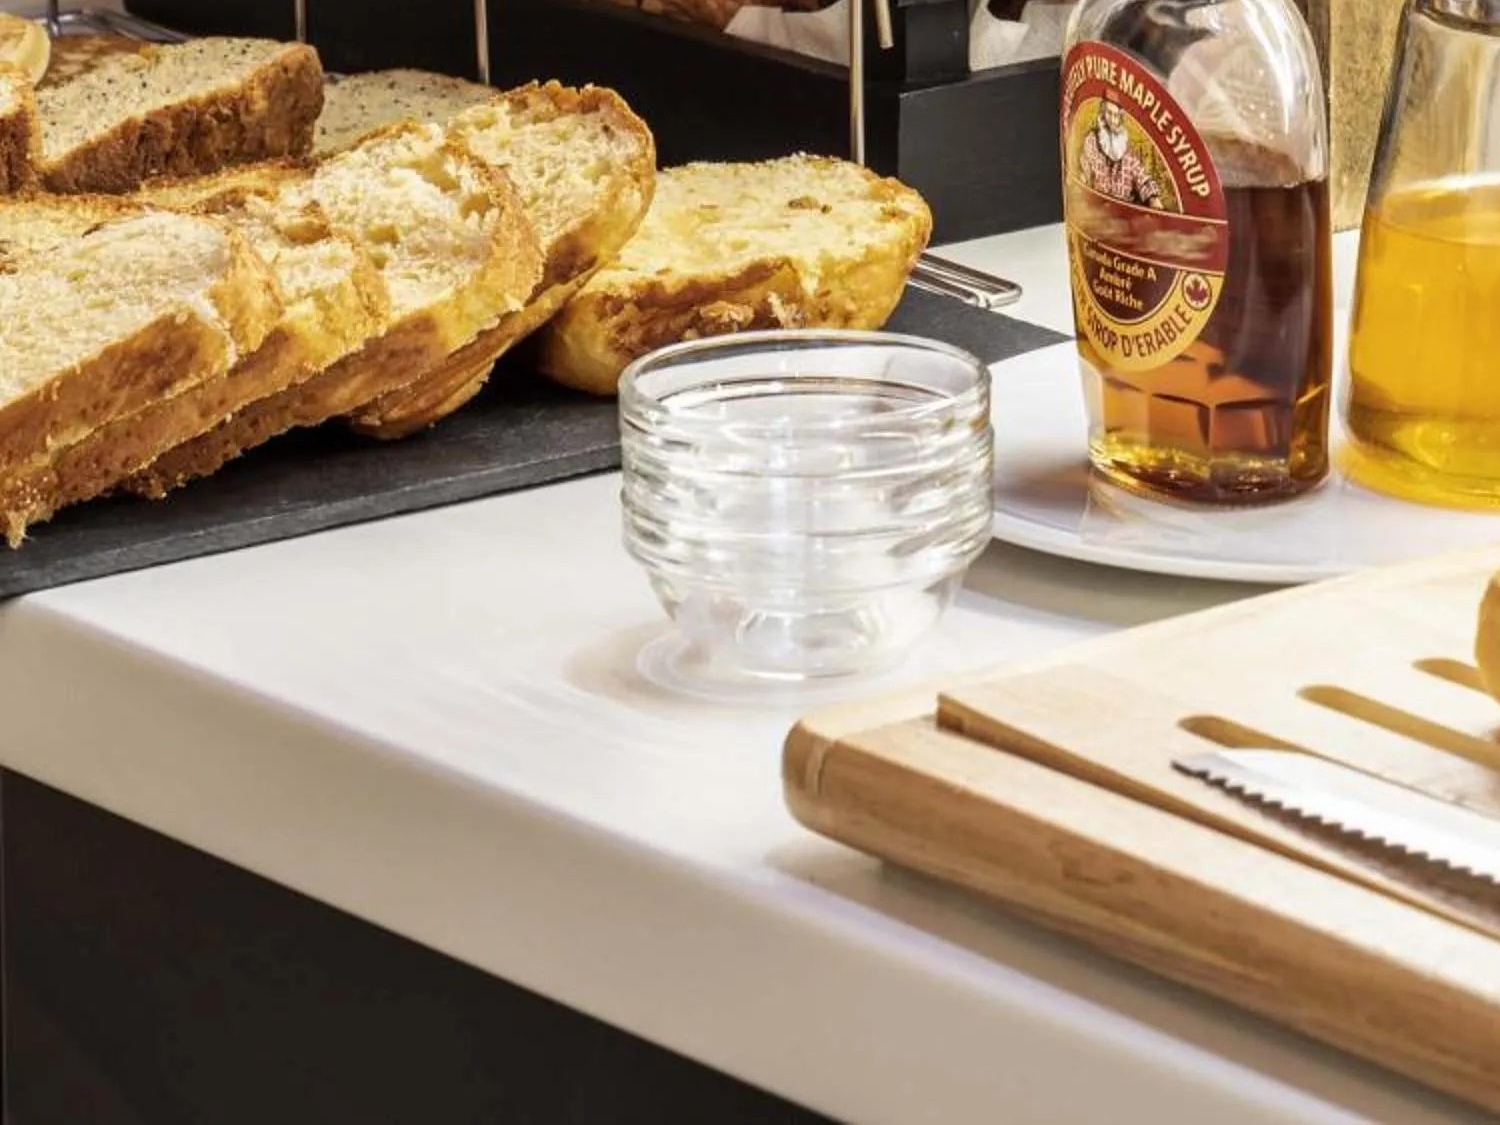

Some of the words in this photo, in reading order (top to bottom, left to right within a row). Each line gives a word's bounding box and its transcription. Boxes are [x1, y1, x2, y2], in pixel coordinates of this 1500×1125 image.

[1086, 55, 1117, 85] PURE
[1119, 67, 1173, 132] MAPLE
[1165, 124, 1211, 197] SYRUP
[1113, 256, 1145, 278] Grade
[1147, 267, 1157, 282] A
[1087, 306, 1119, 351] SIROP
[1121, 304, 1193, 357] D'ERABLE
